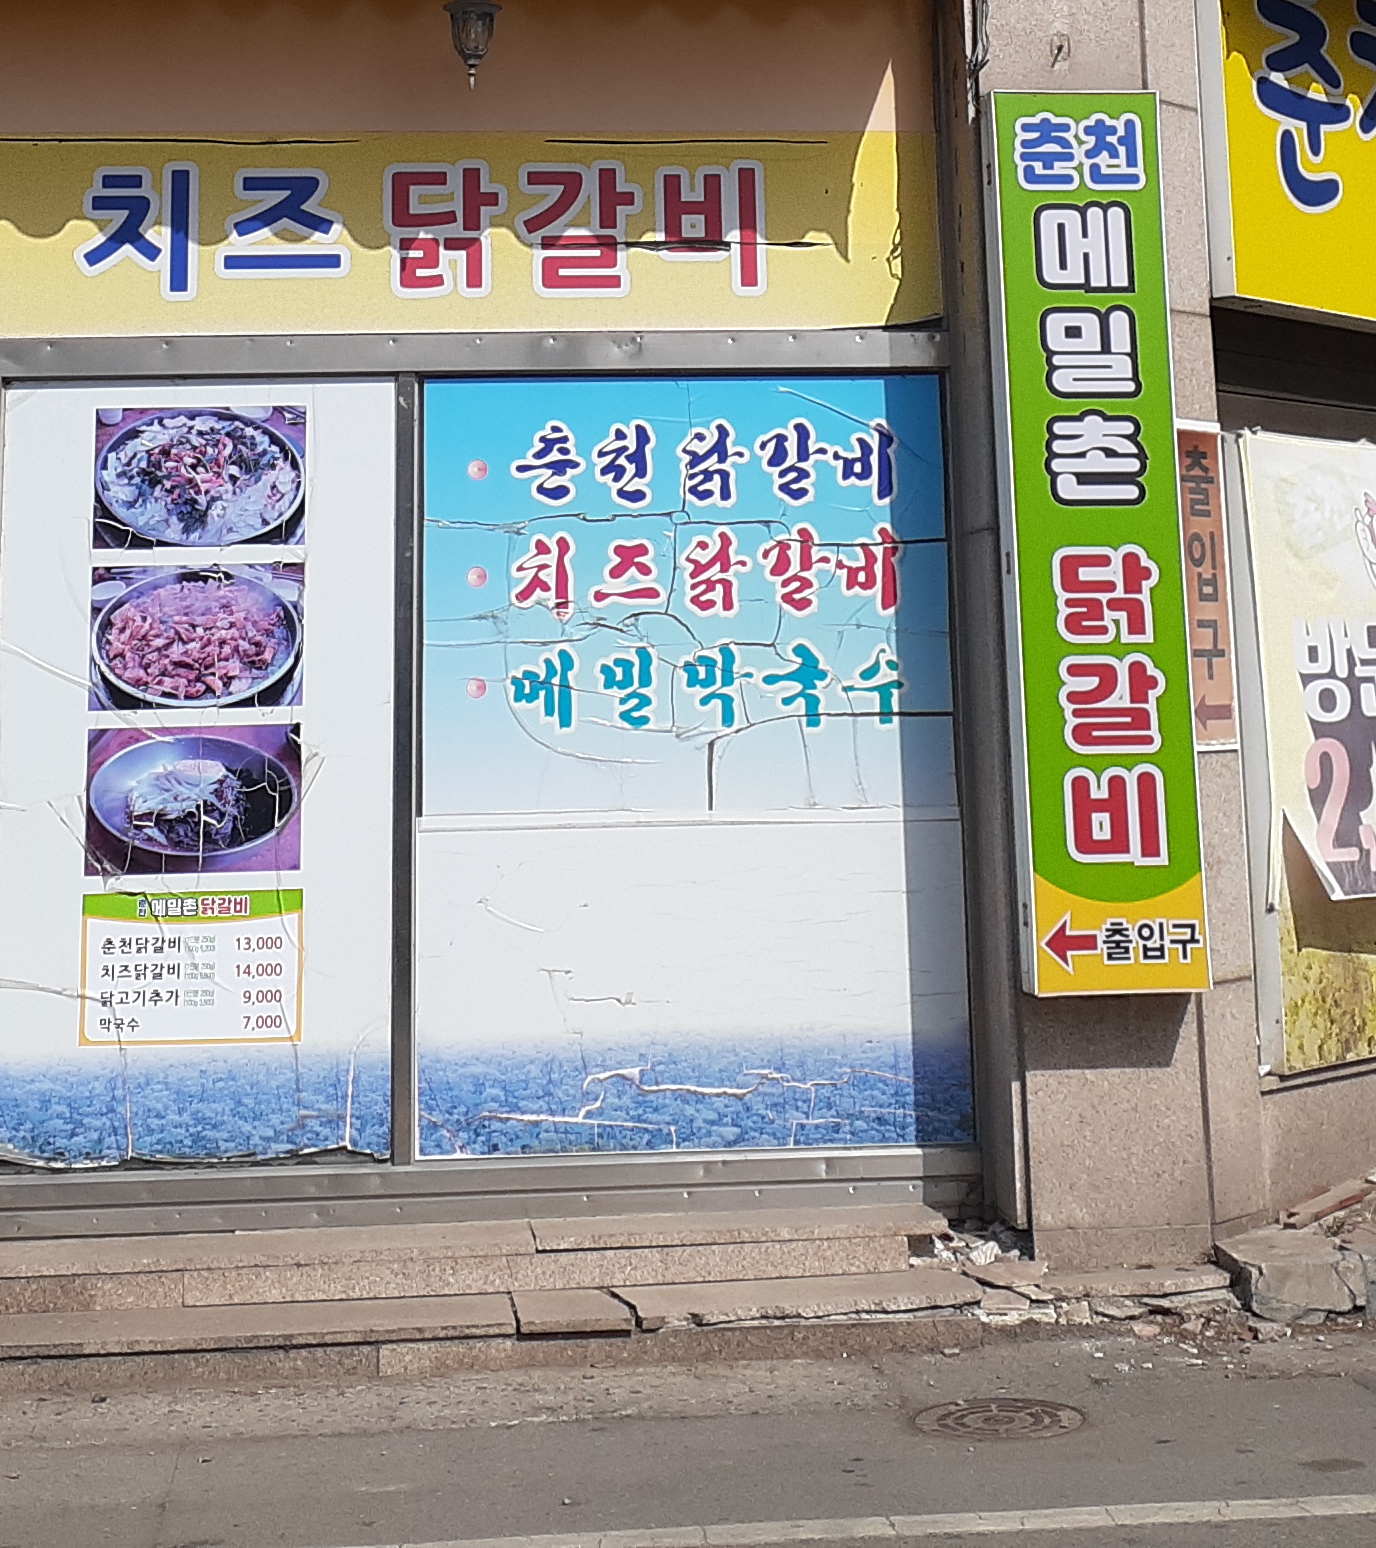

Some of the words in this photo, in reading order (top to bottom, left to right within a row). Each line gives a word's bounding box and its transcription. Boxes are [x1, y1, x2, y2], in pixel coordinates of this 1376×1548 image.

[1015, 112, 1145, 191] 춘천
[82, 162, 350, 299] 치즈
[383, 160, 765, 296] 닭갈비
[1033, 200, 1149, 506] 메밀촌
[511, 419, 898, 506] 춘천닭갈비
[511, 528, 900, 620] 치즈닭갈비
[1181, 445, 1226, 680] 출입구
[510, 640, 905, 730] 메밀막국수
[1052, 544, 1168, 866] 닭갈비
[101, 936, 181, 954] 춘천닭갈비
[236, 936, 283, 952] 13,000
[151, 897, 198, 917] 메밀촌
[200, 896, 249, 915] 닭갈비
[1101, 919, 1202, 965] 출입구
[100, 989, 179, 1007] 닭고기추가
[243, 990, 282, 1005] 9,000
[101, 963, 180, 981] 치즈닭갈비
[235, 963, 283, 979] 14,000
[99, 1018, 140, 1033] 막국수
[243, 1015, 282, 1030] 7,000
